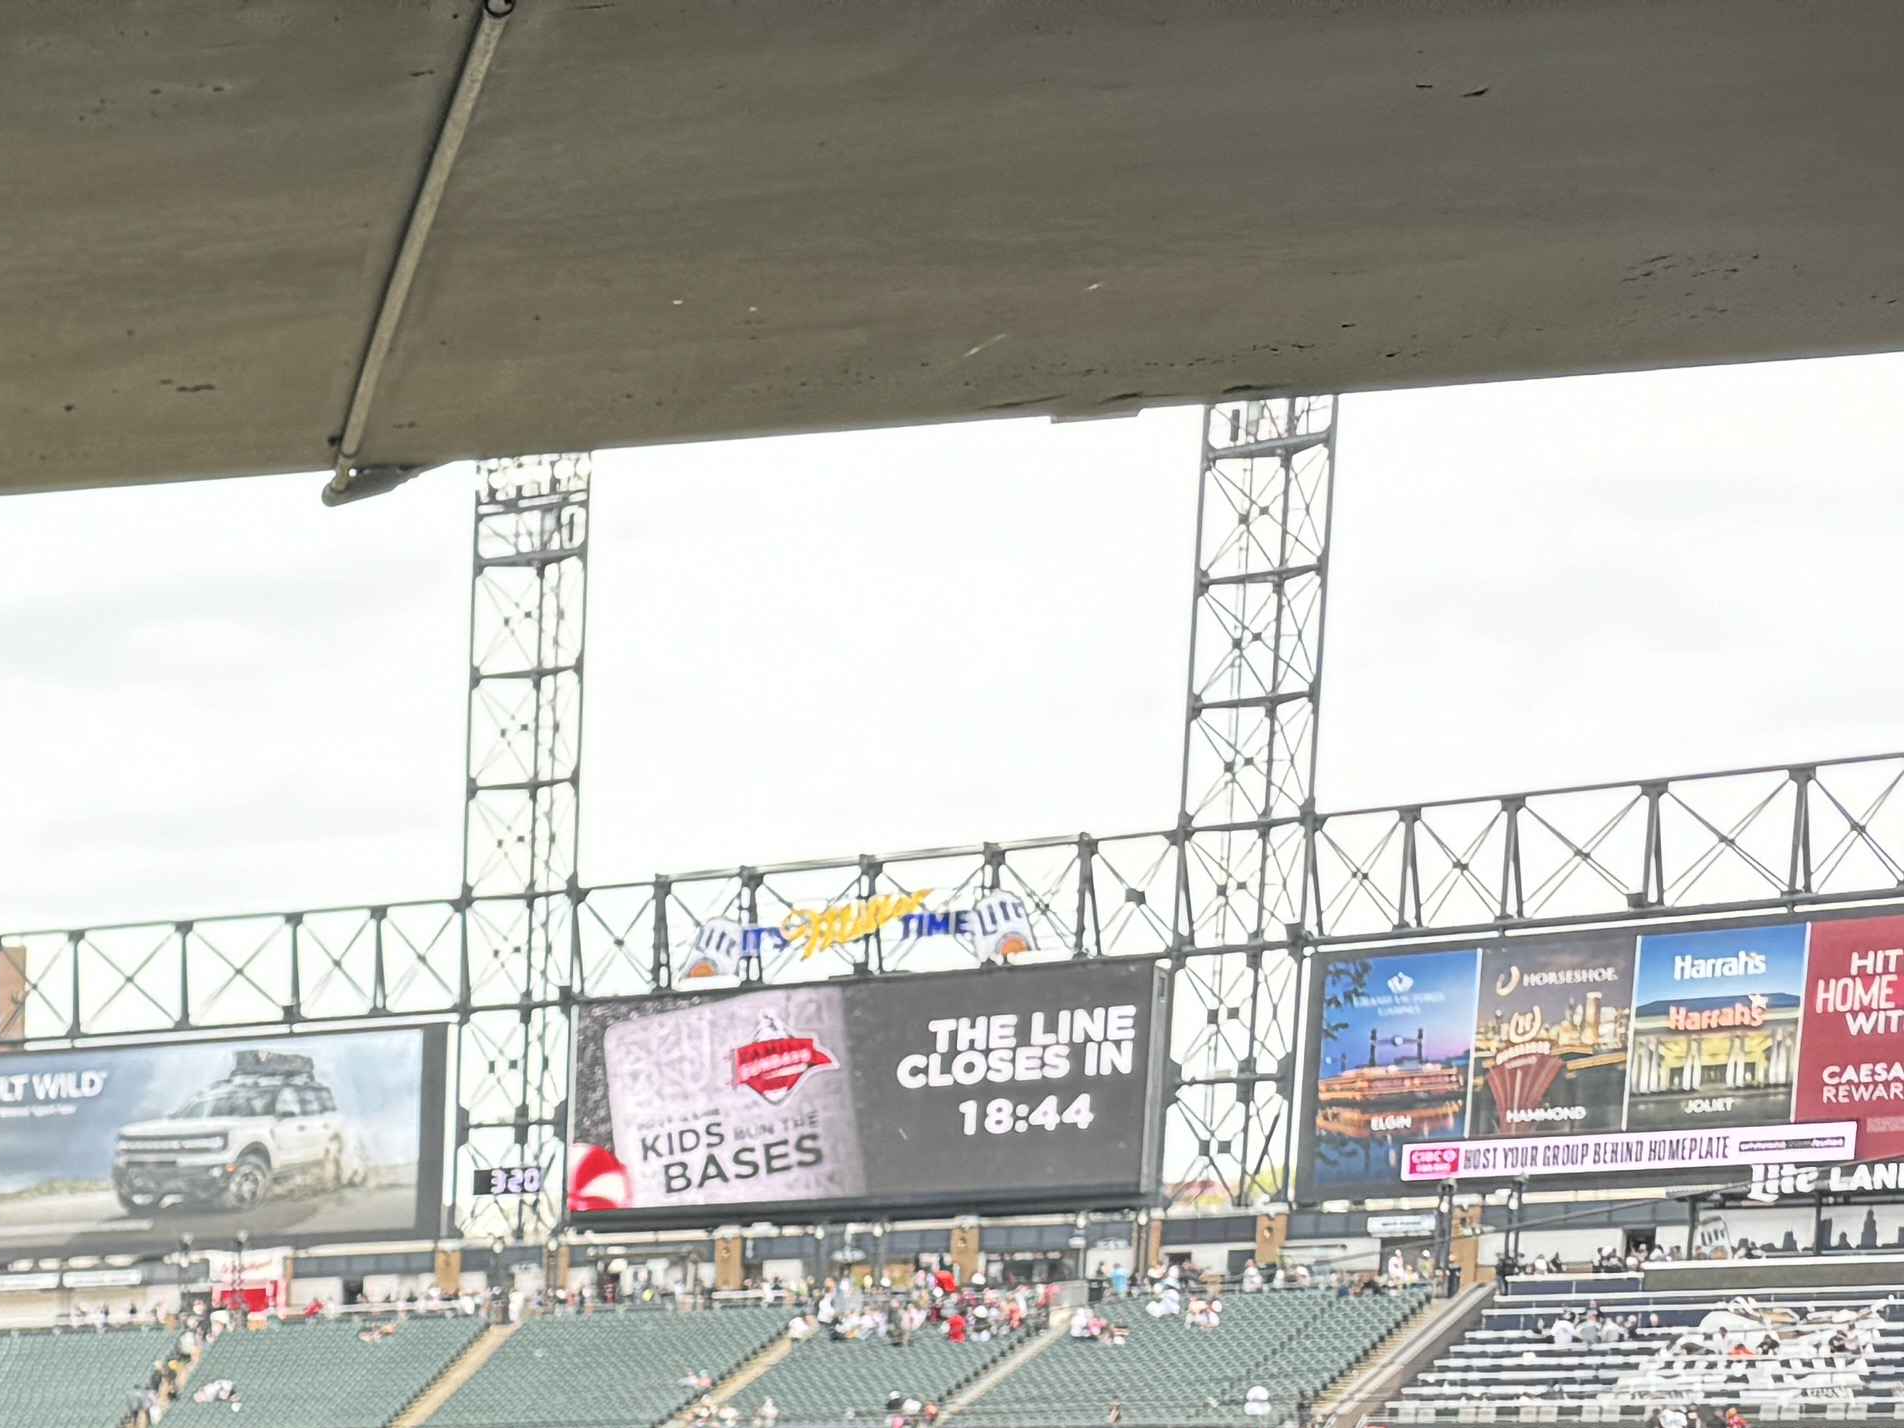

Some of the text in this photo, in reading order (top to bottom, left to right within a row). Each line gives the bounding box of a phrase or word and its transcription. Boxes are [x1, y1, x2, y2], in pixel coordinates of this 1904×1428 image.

[901, 911, 975, 940] TIME
[1850, 949, 1903, 975] HIT
[1522, 967, 1618, 987] HORSESHOE
[1816, 975, 1898, 1013] HOME
[928, 1004, 1137, 1053] THE LINE
[1845, 1009, 1904, 1035] WIT
[896, 1041, 1134, 1089] CLOSES IN
[1821, 1061, 1904, 1085] CAESA
[32, 1069, 106, 1101] WILD
[1822, 1082, 1904, 1104] REWAR
[958, 1093, 1094, 1136] 18:44
[1506, 1105, 1587, 1123] HAMMOND
[1684, 1097, 1734, 1113] JOLIET
[1371, 1115, 1412, 1131] ELGIN
[640, 1122, 725, 1162] KIDS
[1463, 1147, 1498, 1170] HOST
[1503, 1145, 1540, 1168] YOUR
[1542, 1143, 1589, 1167] GROUP
[1593, 1140, 1643, 1164] BEHIND
[1647, 1135, 1730, 1161] HOMEPLATE
[663, 1134, 824, 1194] BASES
[490, 1168, 540, 1195] 320
